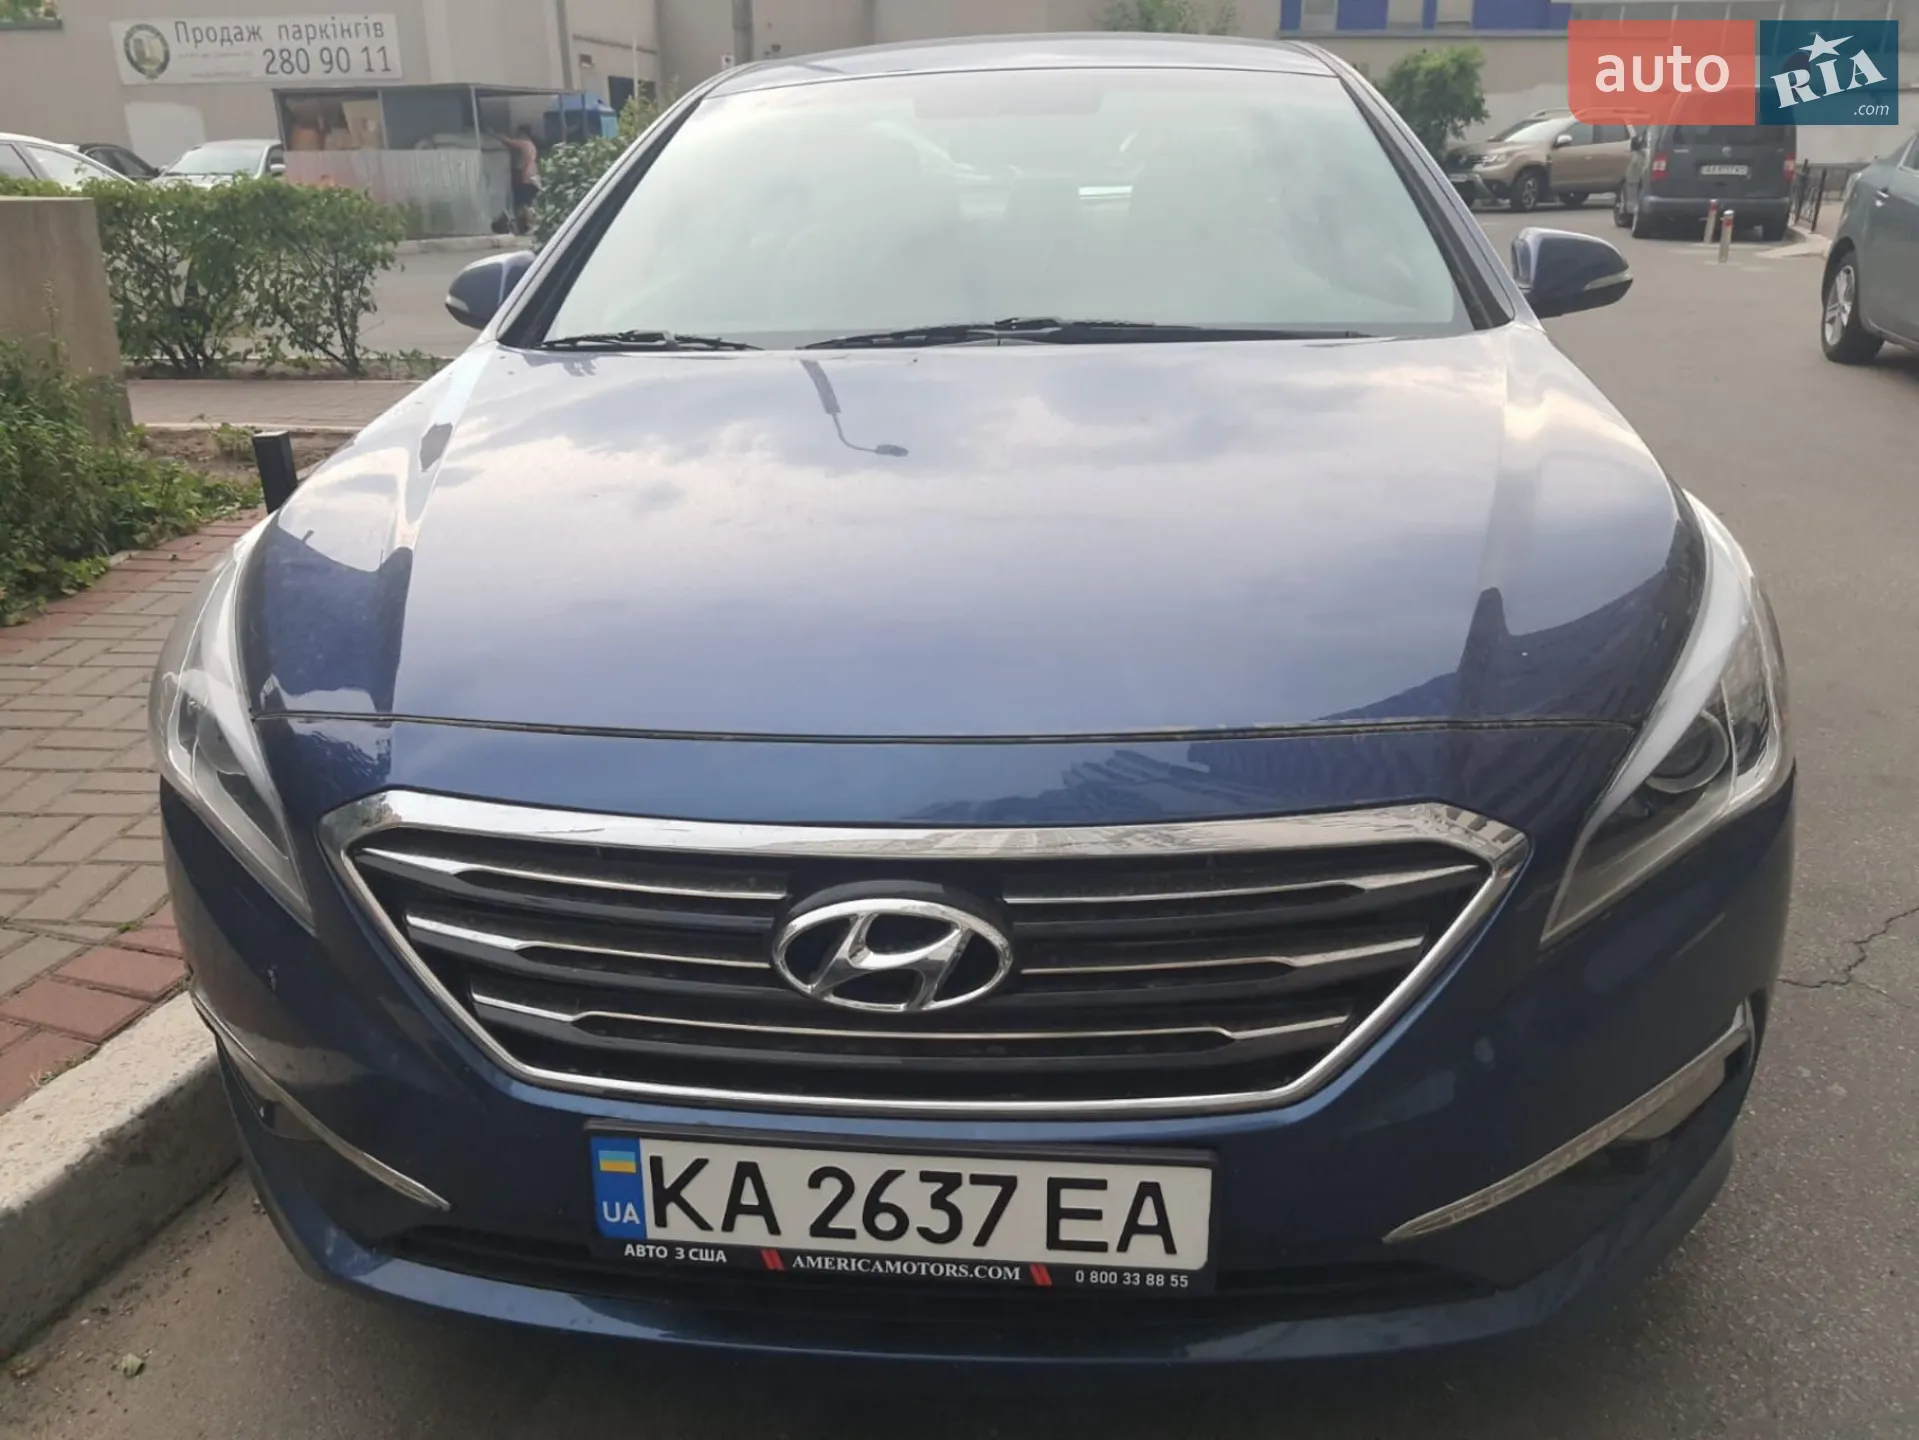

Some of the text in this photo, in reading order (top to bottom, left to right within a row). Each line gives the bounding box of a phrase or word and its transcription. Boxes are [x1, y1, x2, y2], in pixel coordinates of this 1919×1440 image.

[174, 15, 385, 49] Продаж паркінгів
[262, 45, 391, 75] 280 90 11
[602, 1200, 641, 1225] UA
[649, 1155, 1178, 1256] KA 2637 EA
[624, 1243, 668, 1259] АВТО
[688, 1248, 727, 1263] США
[792, 1255, 1021, 1281] AMERICAMOTORS.COM
[1075, 1270, 1189, 1288] 0 800 33 88 55
